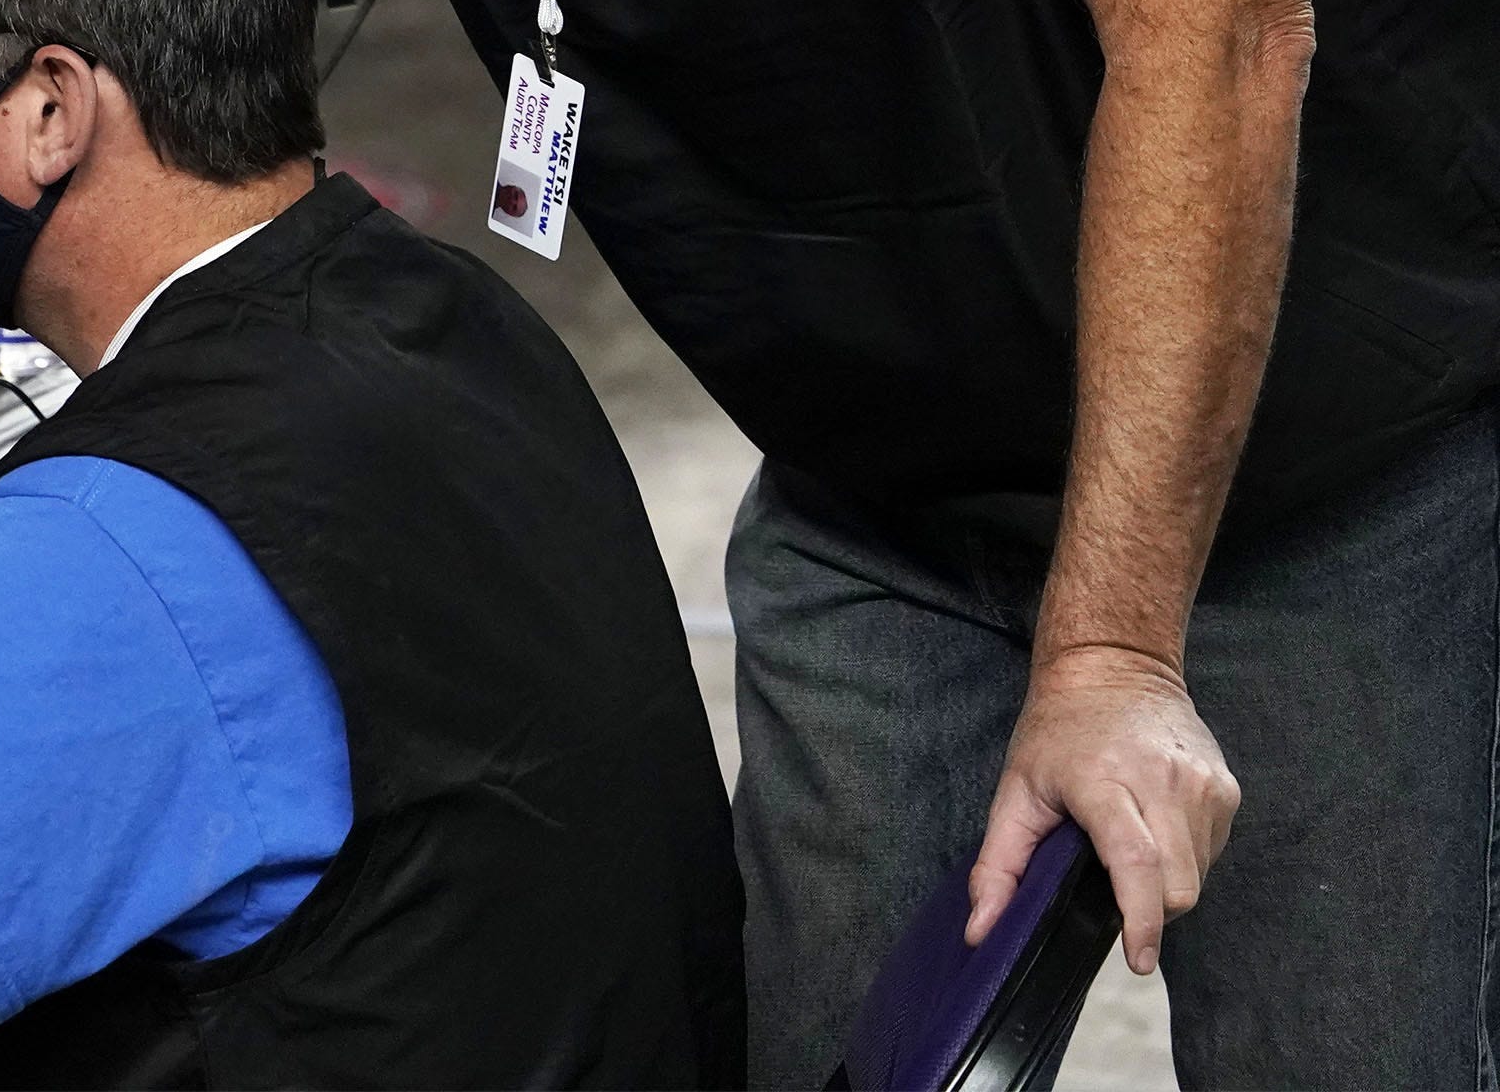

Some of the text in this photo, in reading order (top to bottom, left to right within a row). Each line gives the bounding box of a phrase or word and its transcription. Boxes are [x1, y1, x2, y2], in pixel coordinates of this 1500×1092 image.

[508, 77, 529, 150] AUDIT TEAM
[522, 96, 538, 145] COUNTY
[532, 93, 550, 155] MARICOPA
[538, 131, 562, 236] MATTHEW
[553, 102, 578, 206] WAKE TSI
